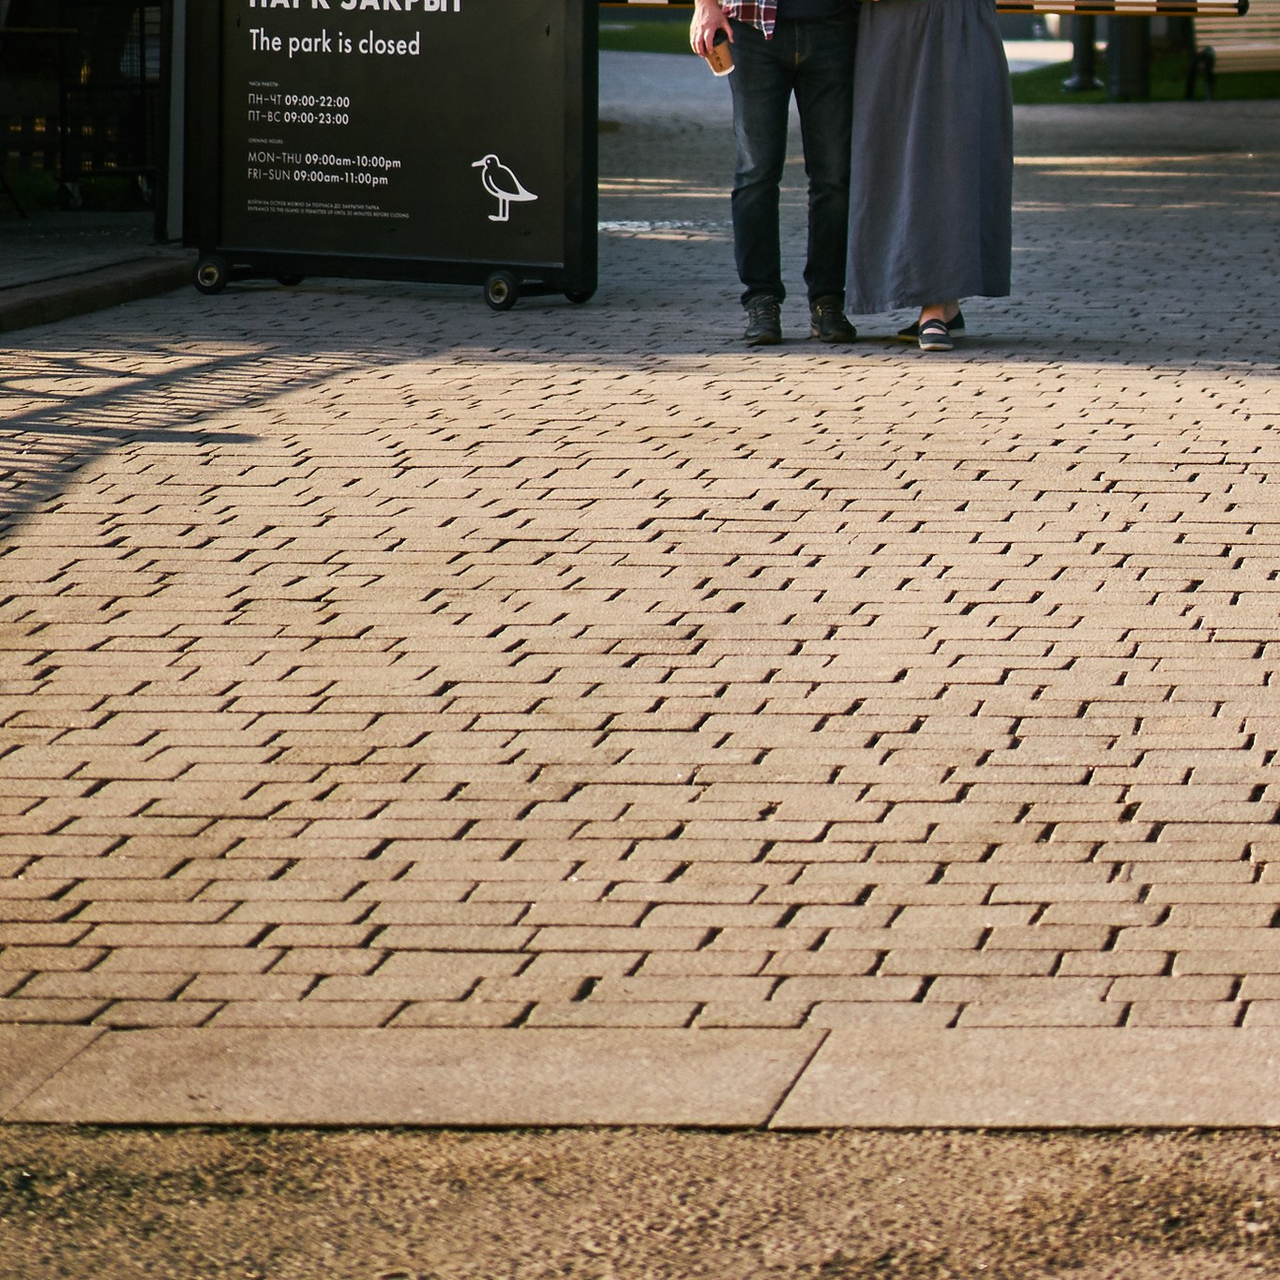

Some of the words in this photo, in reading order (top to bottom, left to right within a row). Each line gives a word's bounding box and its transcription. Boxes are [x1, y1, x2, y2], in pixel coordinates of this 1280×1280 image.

[249, 27, 282, 52] The
[288, 28, 332, 58] park
[338, 31, 352, 53] is
[358, 30, 420, 55] closed
[248, 93, 282, 105] ПН-ЧТ
[284, 94, 350, 108] 09:00-22:00
[248, 110, 281, 122] ПТ-ВС
[284, 111, 349, 125] 09:00-23:00
[248, 151, 302, 164] MON-THU
[305, 153, 401, 170] 09:00am-10:00pm
[247, 168, 291, 180] FRI-SUN
[293, 170, 388, 187] 09:00am-11:00pm
